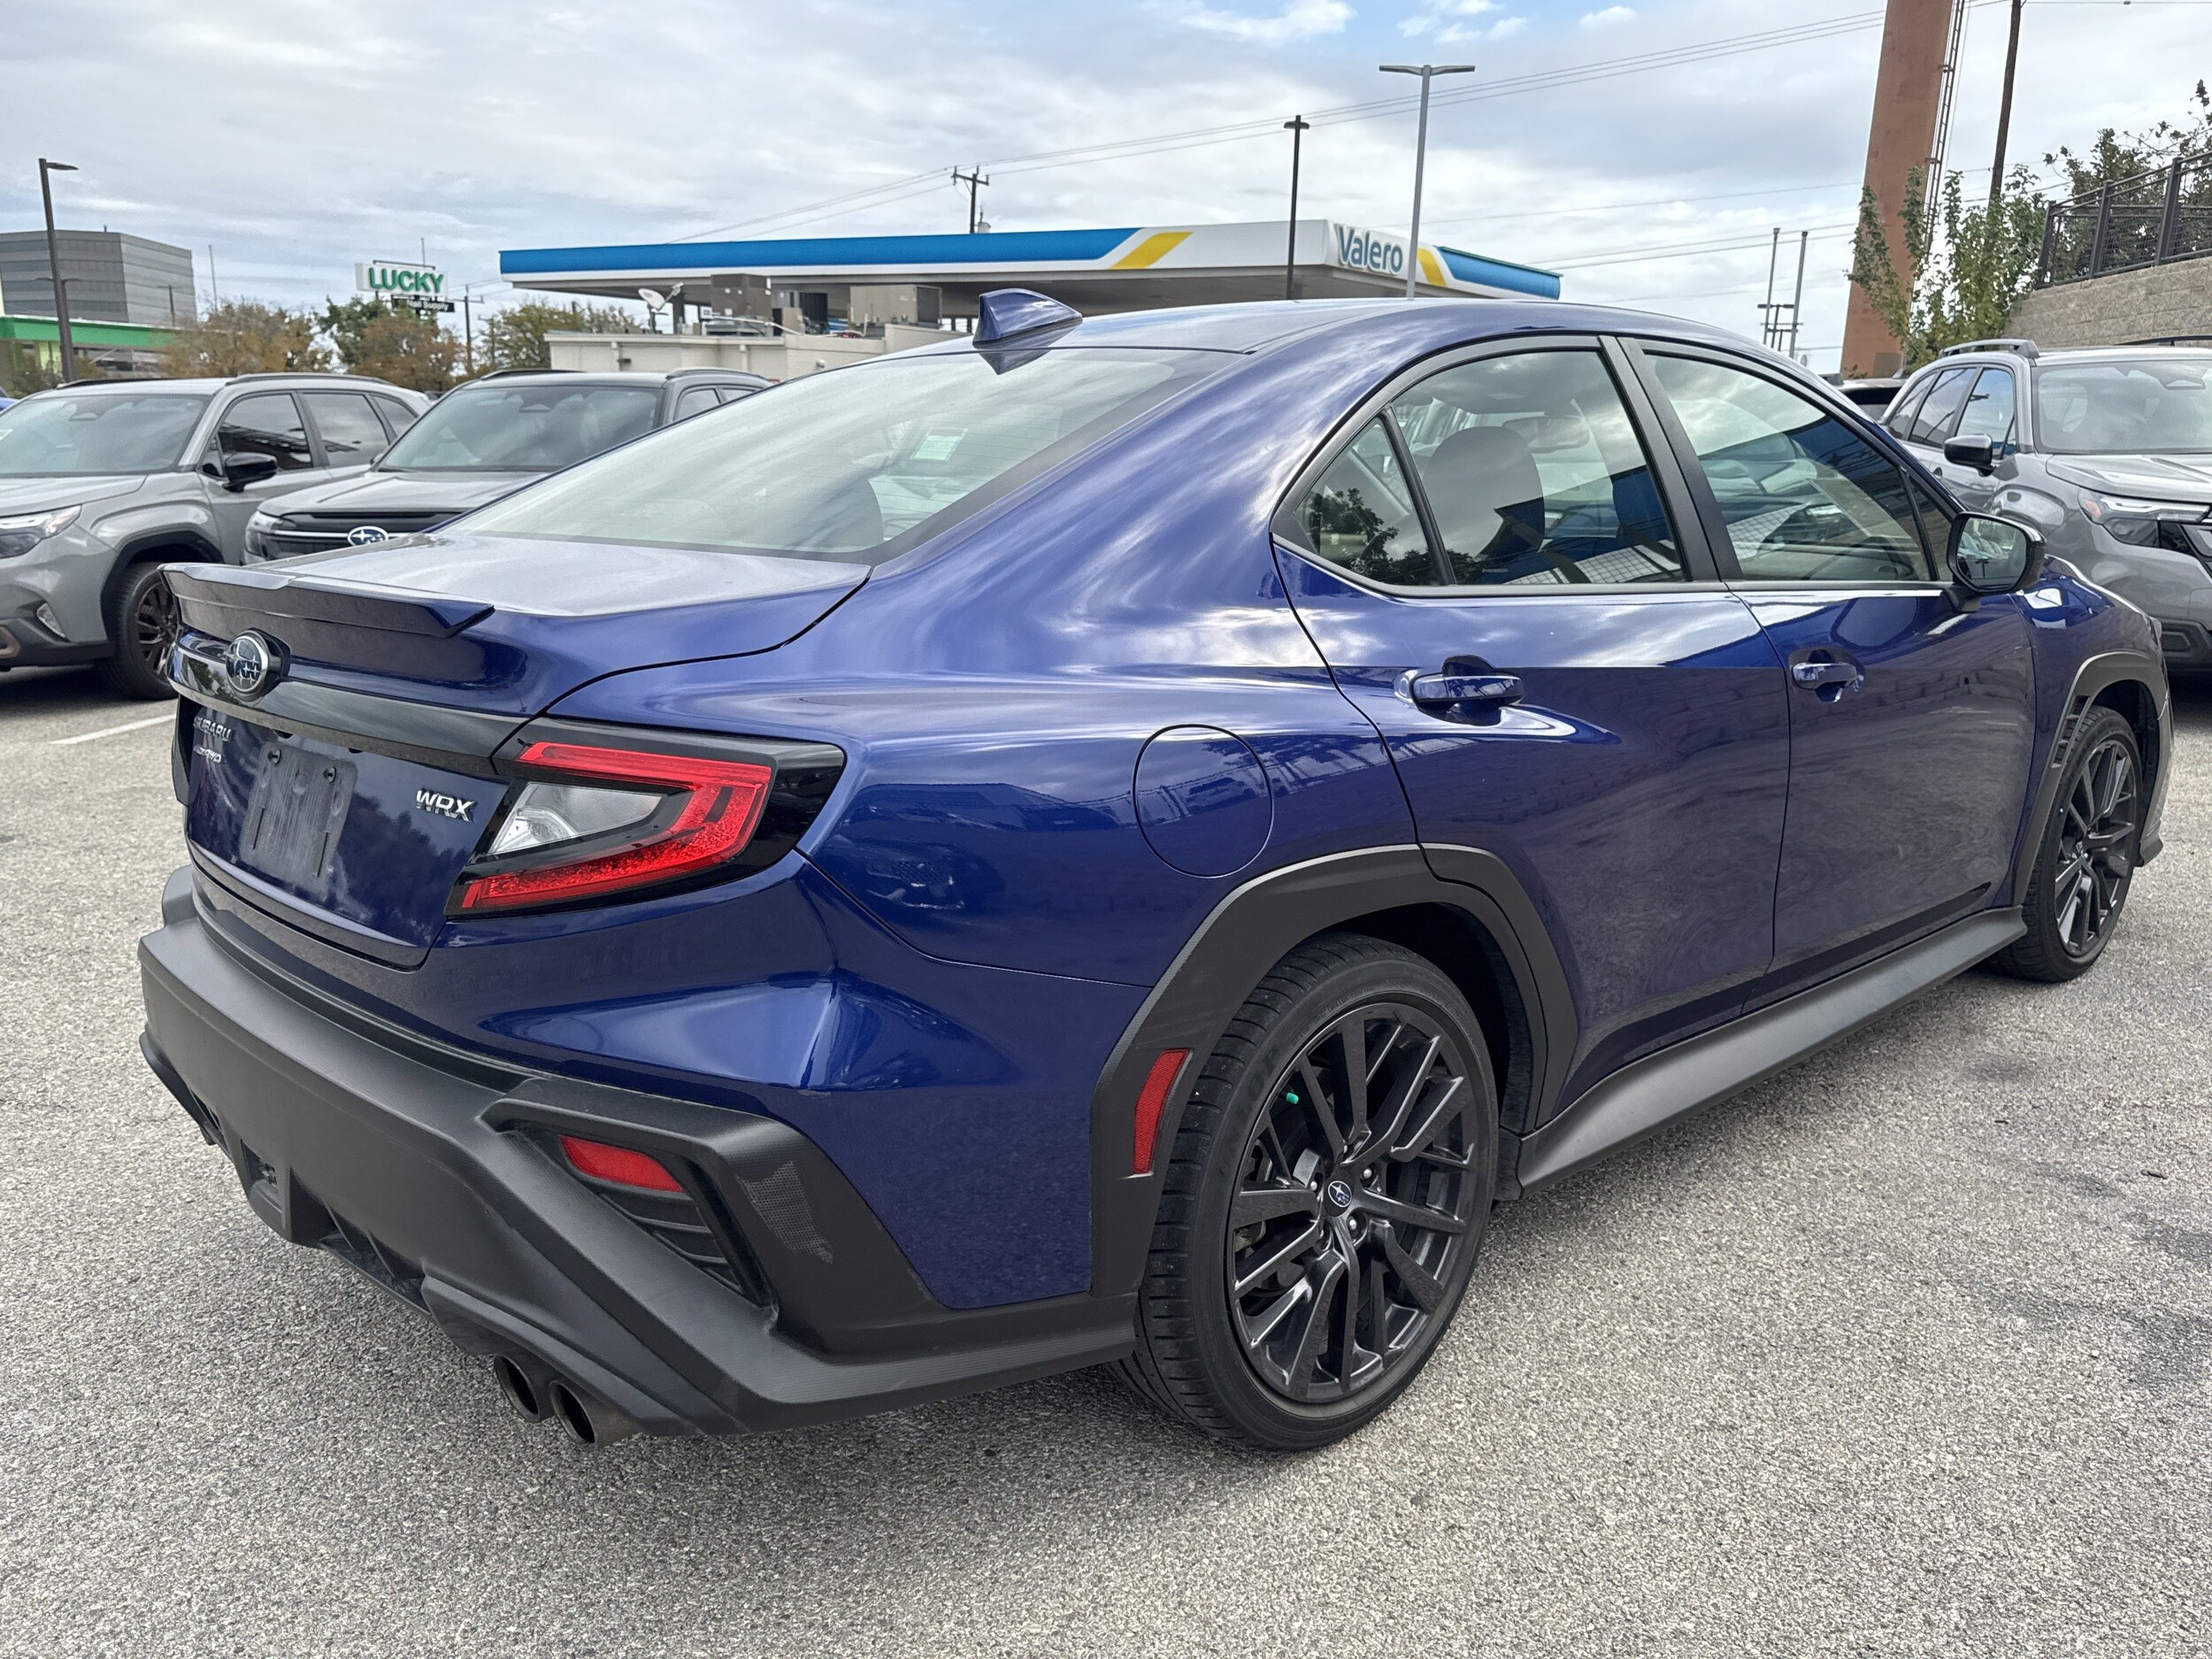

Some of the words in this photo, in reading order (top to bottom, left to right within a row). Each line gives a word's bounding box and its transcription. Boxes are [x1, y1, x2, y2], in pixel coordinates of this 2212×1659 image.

[1339, 227, 1402, 273] Valero
[369, 267, 444, 294] LUCKY
[193, 716, 232, 742] SUBARU
[416, 790, 475, 823] WRX
